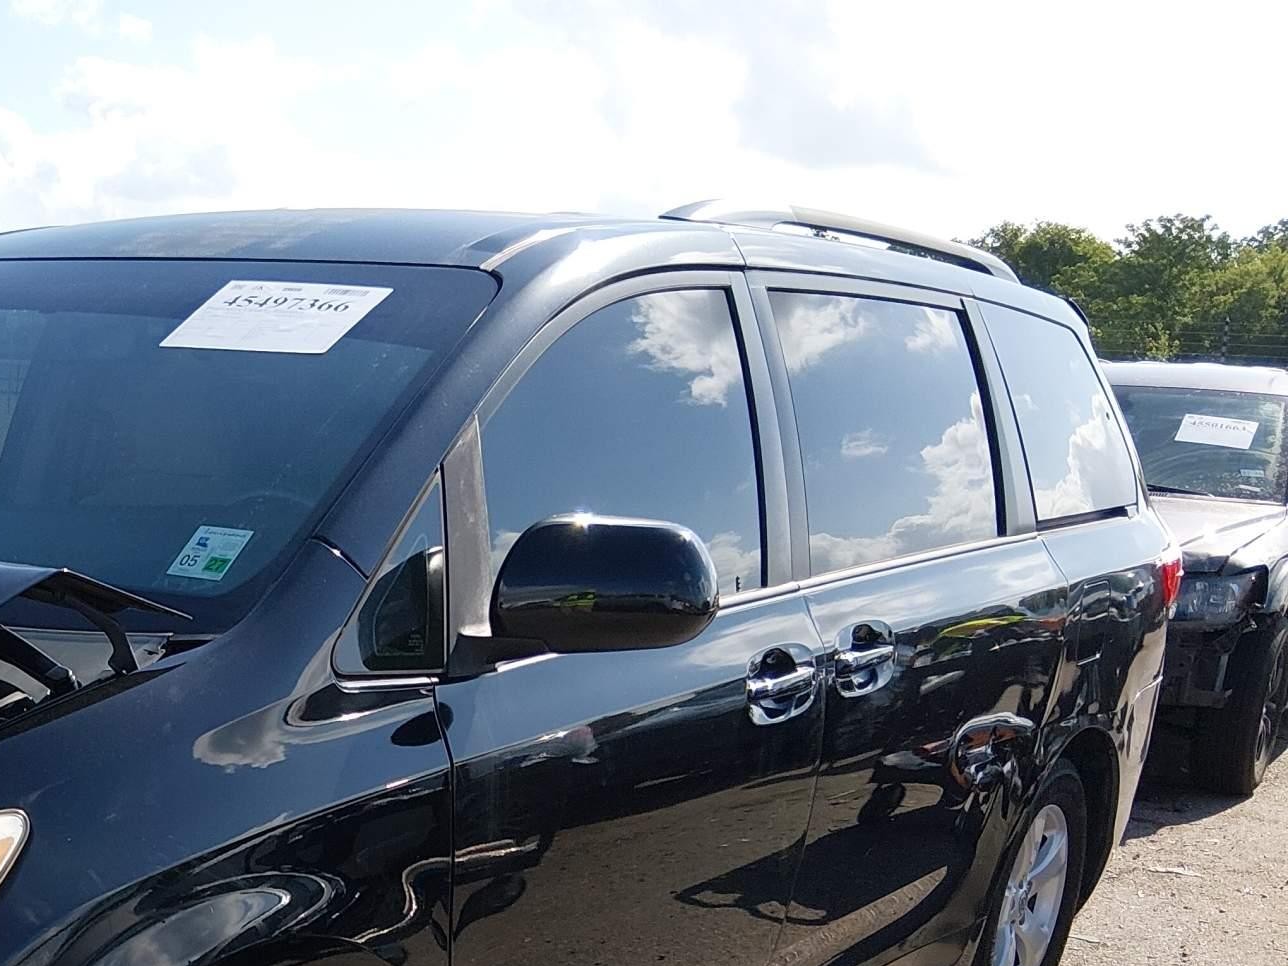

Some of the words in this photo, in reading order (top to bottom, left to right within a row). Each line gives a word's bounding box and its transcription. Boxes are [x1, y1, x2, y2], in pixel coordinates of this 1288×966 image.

[223, 295, 352, 312] 45497366
[179, 554, 200, 567] 05
[203, 558, 230, 572] 27
